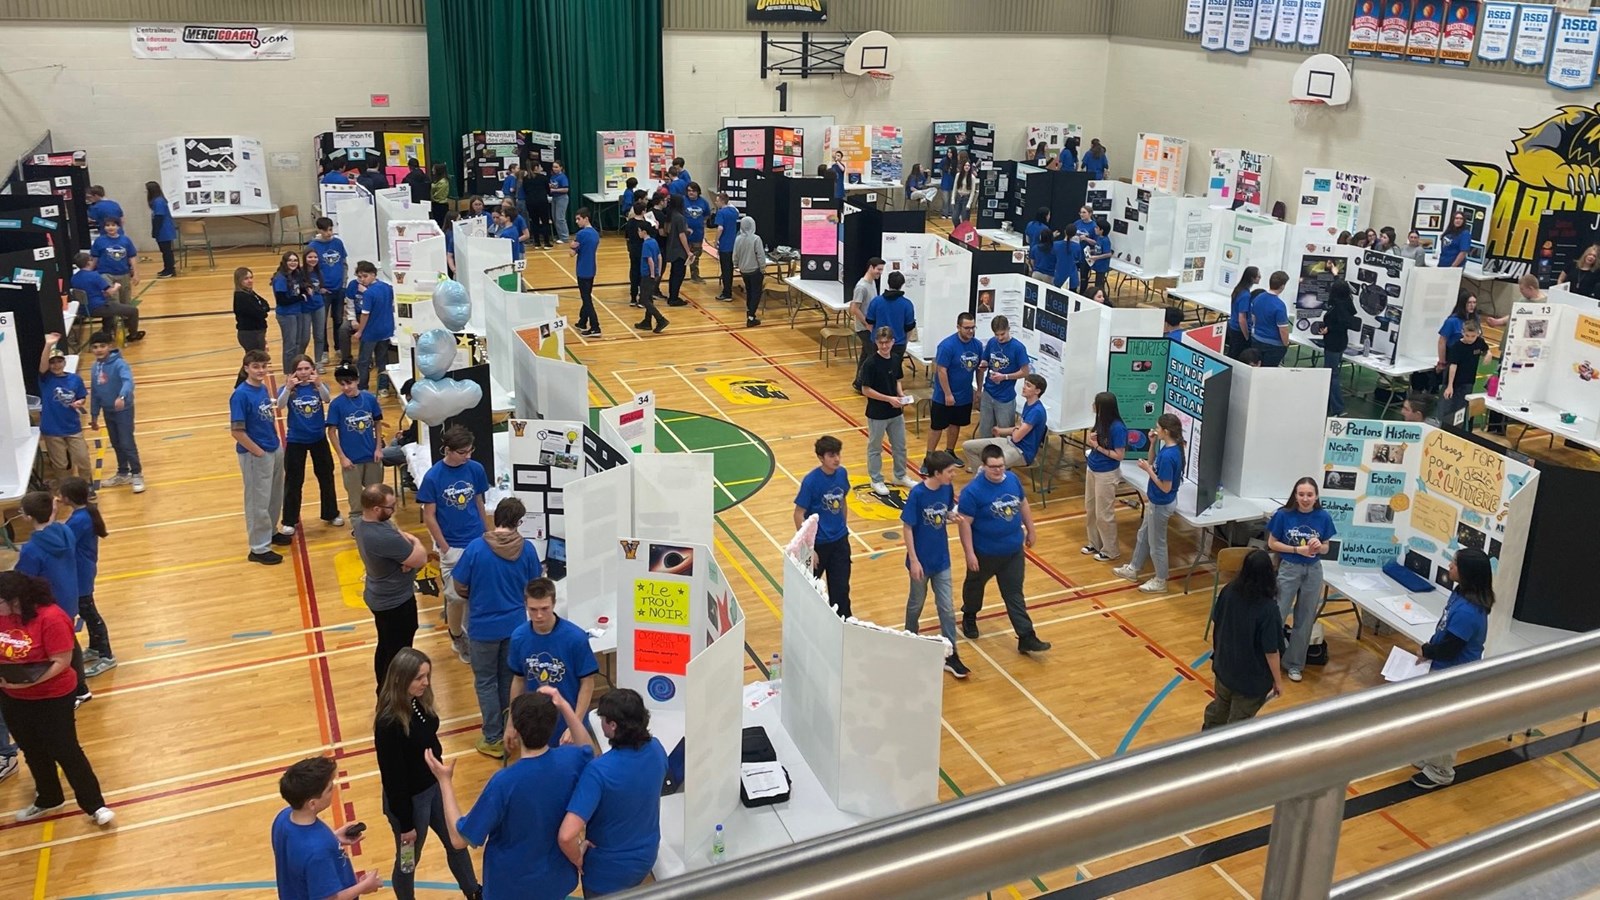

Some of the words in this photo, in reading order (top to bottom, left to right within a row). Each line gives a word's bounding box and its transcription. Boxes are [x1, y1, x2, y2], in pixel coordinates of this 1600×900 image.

[1488, 10, 1512, 20] RSEQ
[1523, 13, 1548, 22] RSEQ
[1562, 18, 1597, 31] RSEQ
[1561, 68, 1580, 76] RSEQ
[775, 82, 787, 111] 1
[554, 320, 564, 328] 33
[1192, 354, 1204, 368] LE
[638, 395, 649, 405] 34
[1346, 422, 1382, 437] Parlons
[1386, 426, 1420, 440] Histoire
[1329, 442, 1359, 452] Newton
[1429, 456, 1453, 470] pour
[1473, 448, 1505, 470] FORT
[1371, 473, 1402, 485] Einstein
[1426, 469, 1440, 488] la
[1321, 500, 1354, 513] Eddington
[1342, 543, 1365, 554] Walsh
[1366, 545, 1400, 555] Carswell
[649, 582, 671, 598] Le
[641, 597, 674, 607] TROU
[648, 608, 684, 620] NOIR
